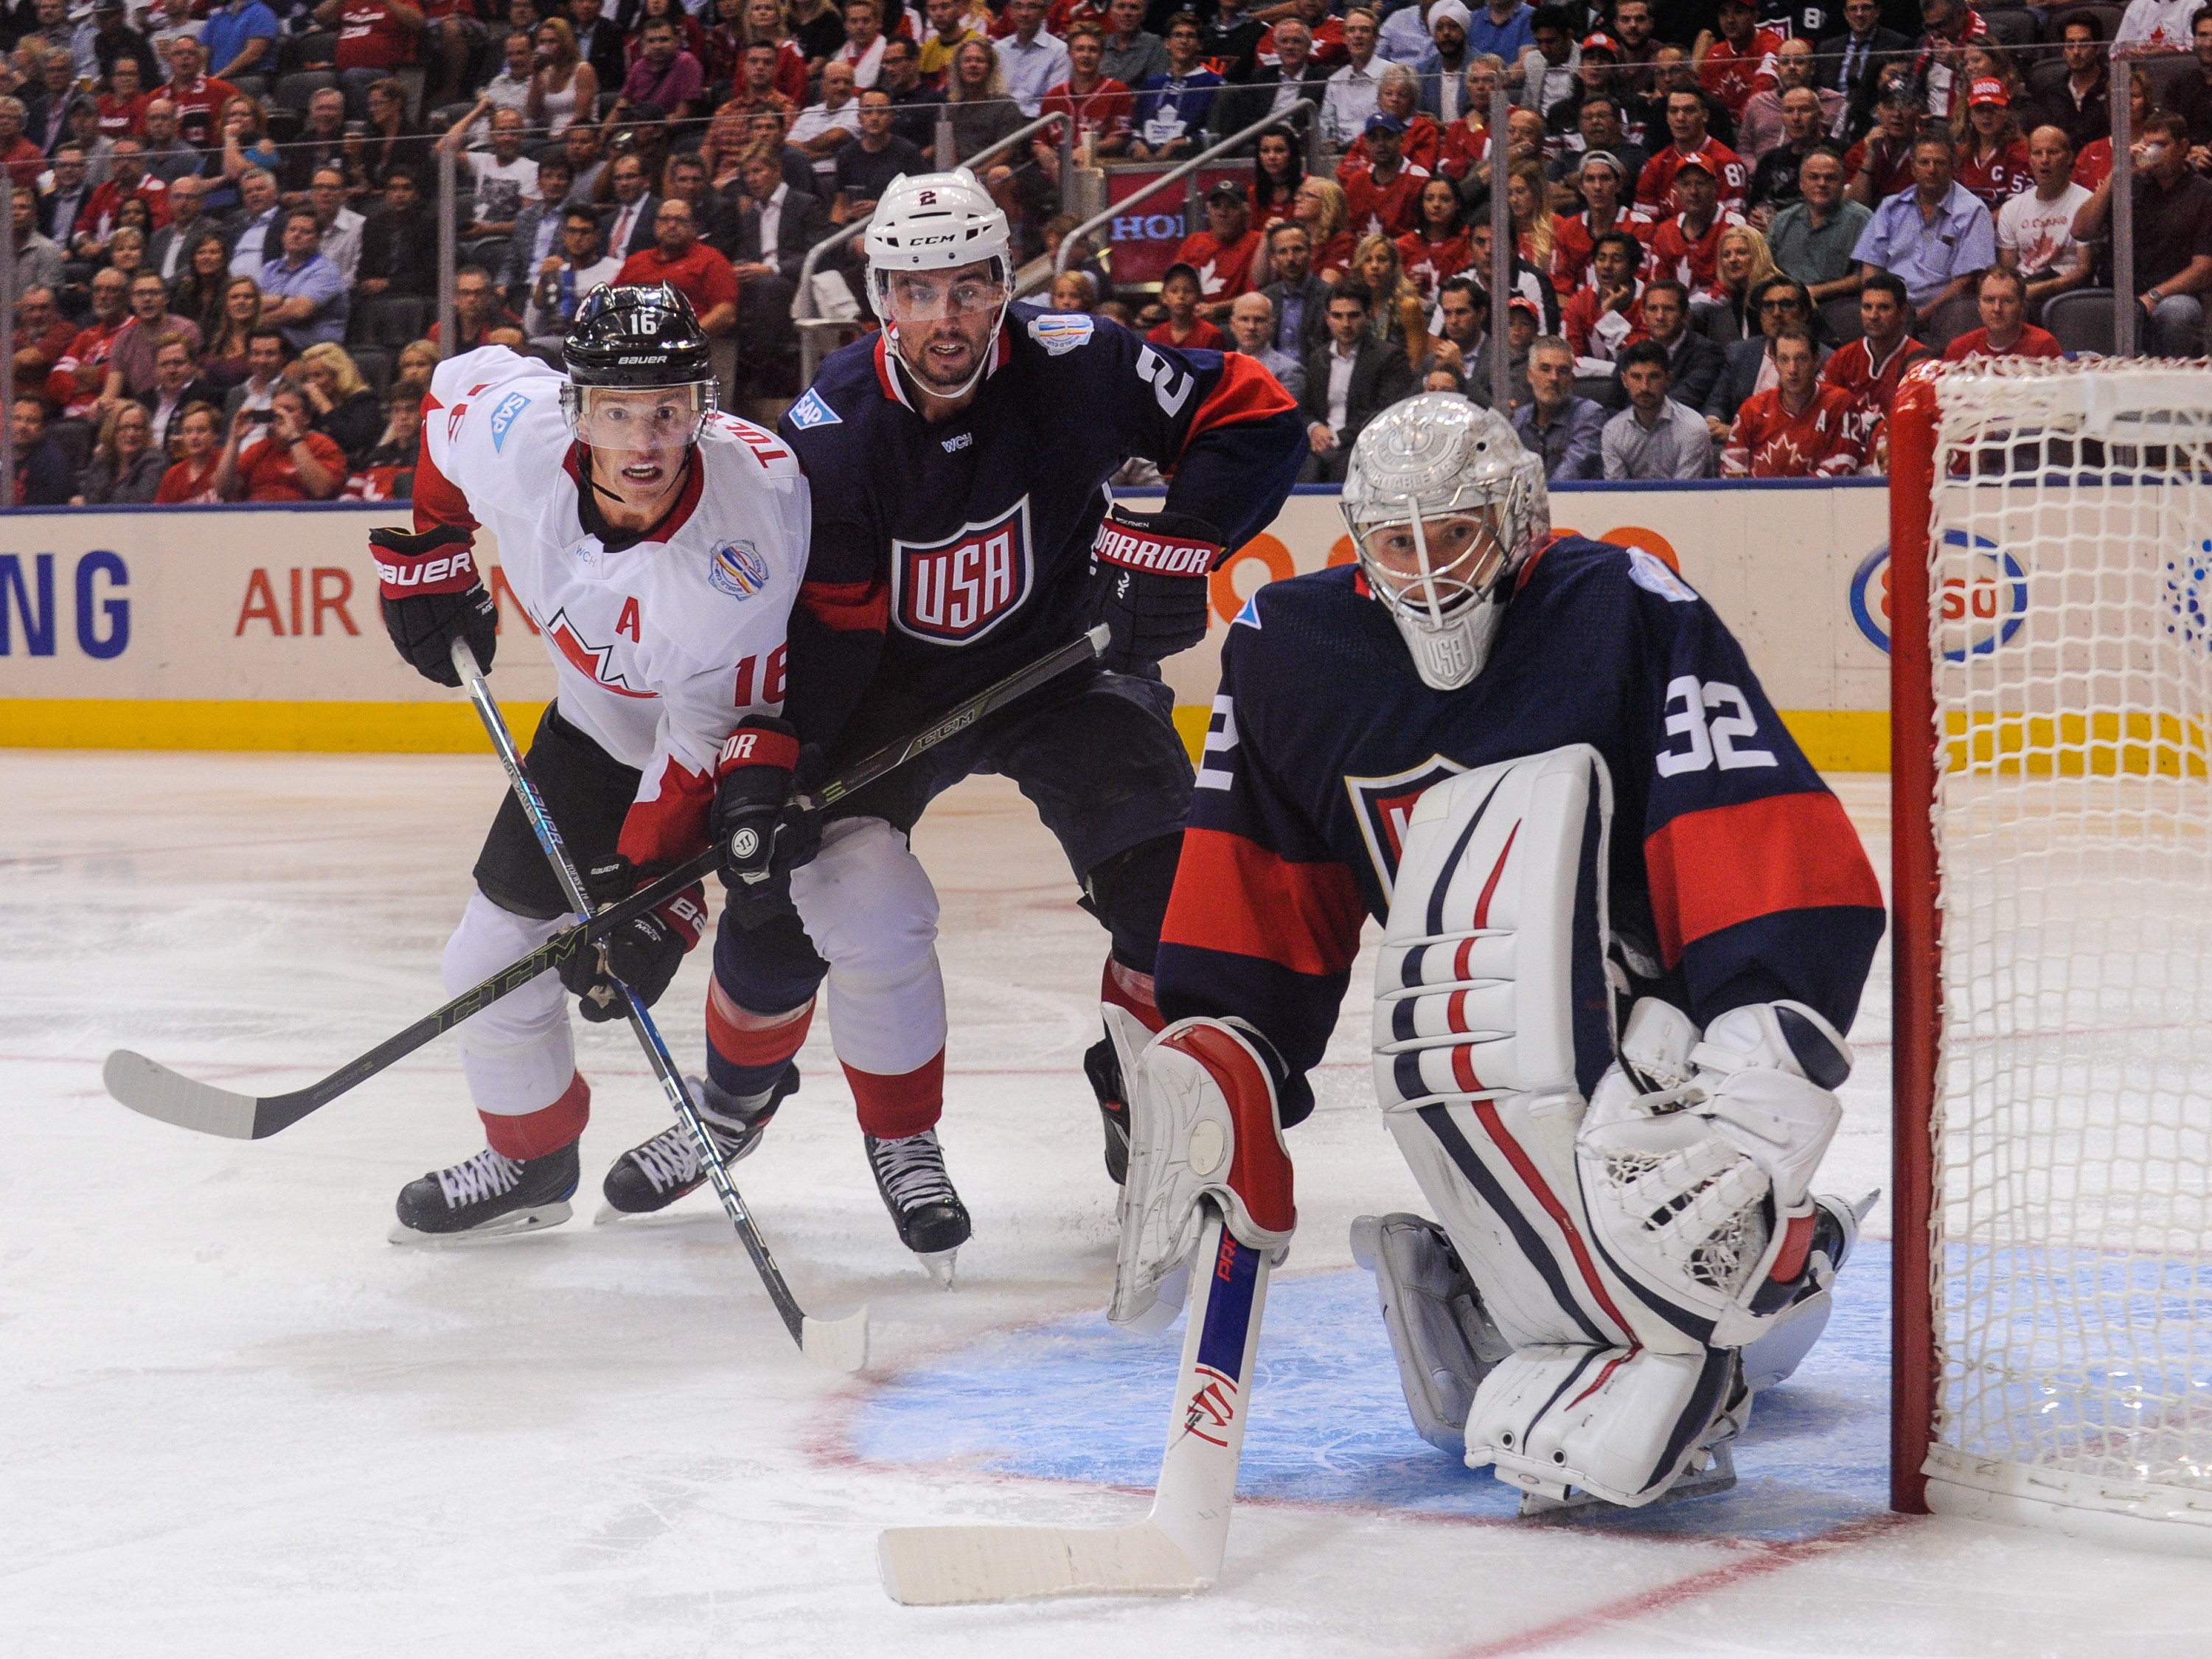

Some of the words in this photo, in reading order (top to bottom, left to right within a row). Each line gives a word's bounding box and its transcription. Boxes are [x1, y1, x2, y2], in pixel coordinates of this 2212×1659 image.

[919, 190, 936, 206] 2
[909, 234, 956, 246] CCM
[630, 313, 657, 335] 16
[1135, 344, 1194, 418] 2
[491, 393, 526, 434] SAP
[797, 395, 823, 425] SAP
[1815, 409, 1826, 432] A
[941, 432, 973, 453] WCH
[577, 544, 597, 568] WCH
[916, 531, 1011, 629] USA
[234, 567, 361, 637] AIR
[615, 596, 641, 644] A
[1425, 635, 1467, 678] USA
[917, 709, 975, 750] CCM
[1655, 675, 1779, 779] 32
[431, 924, 588, 1034] CCM
